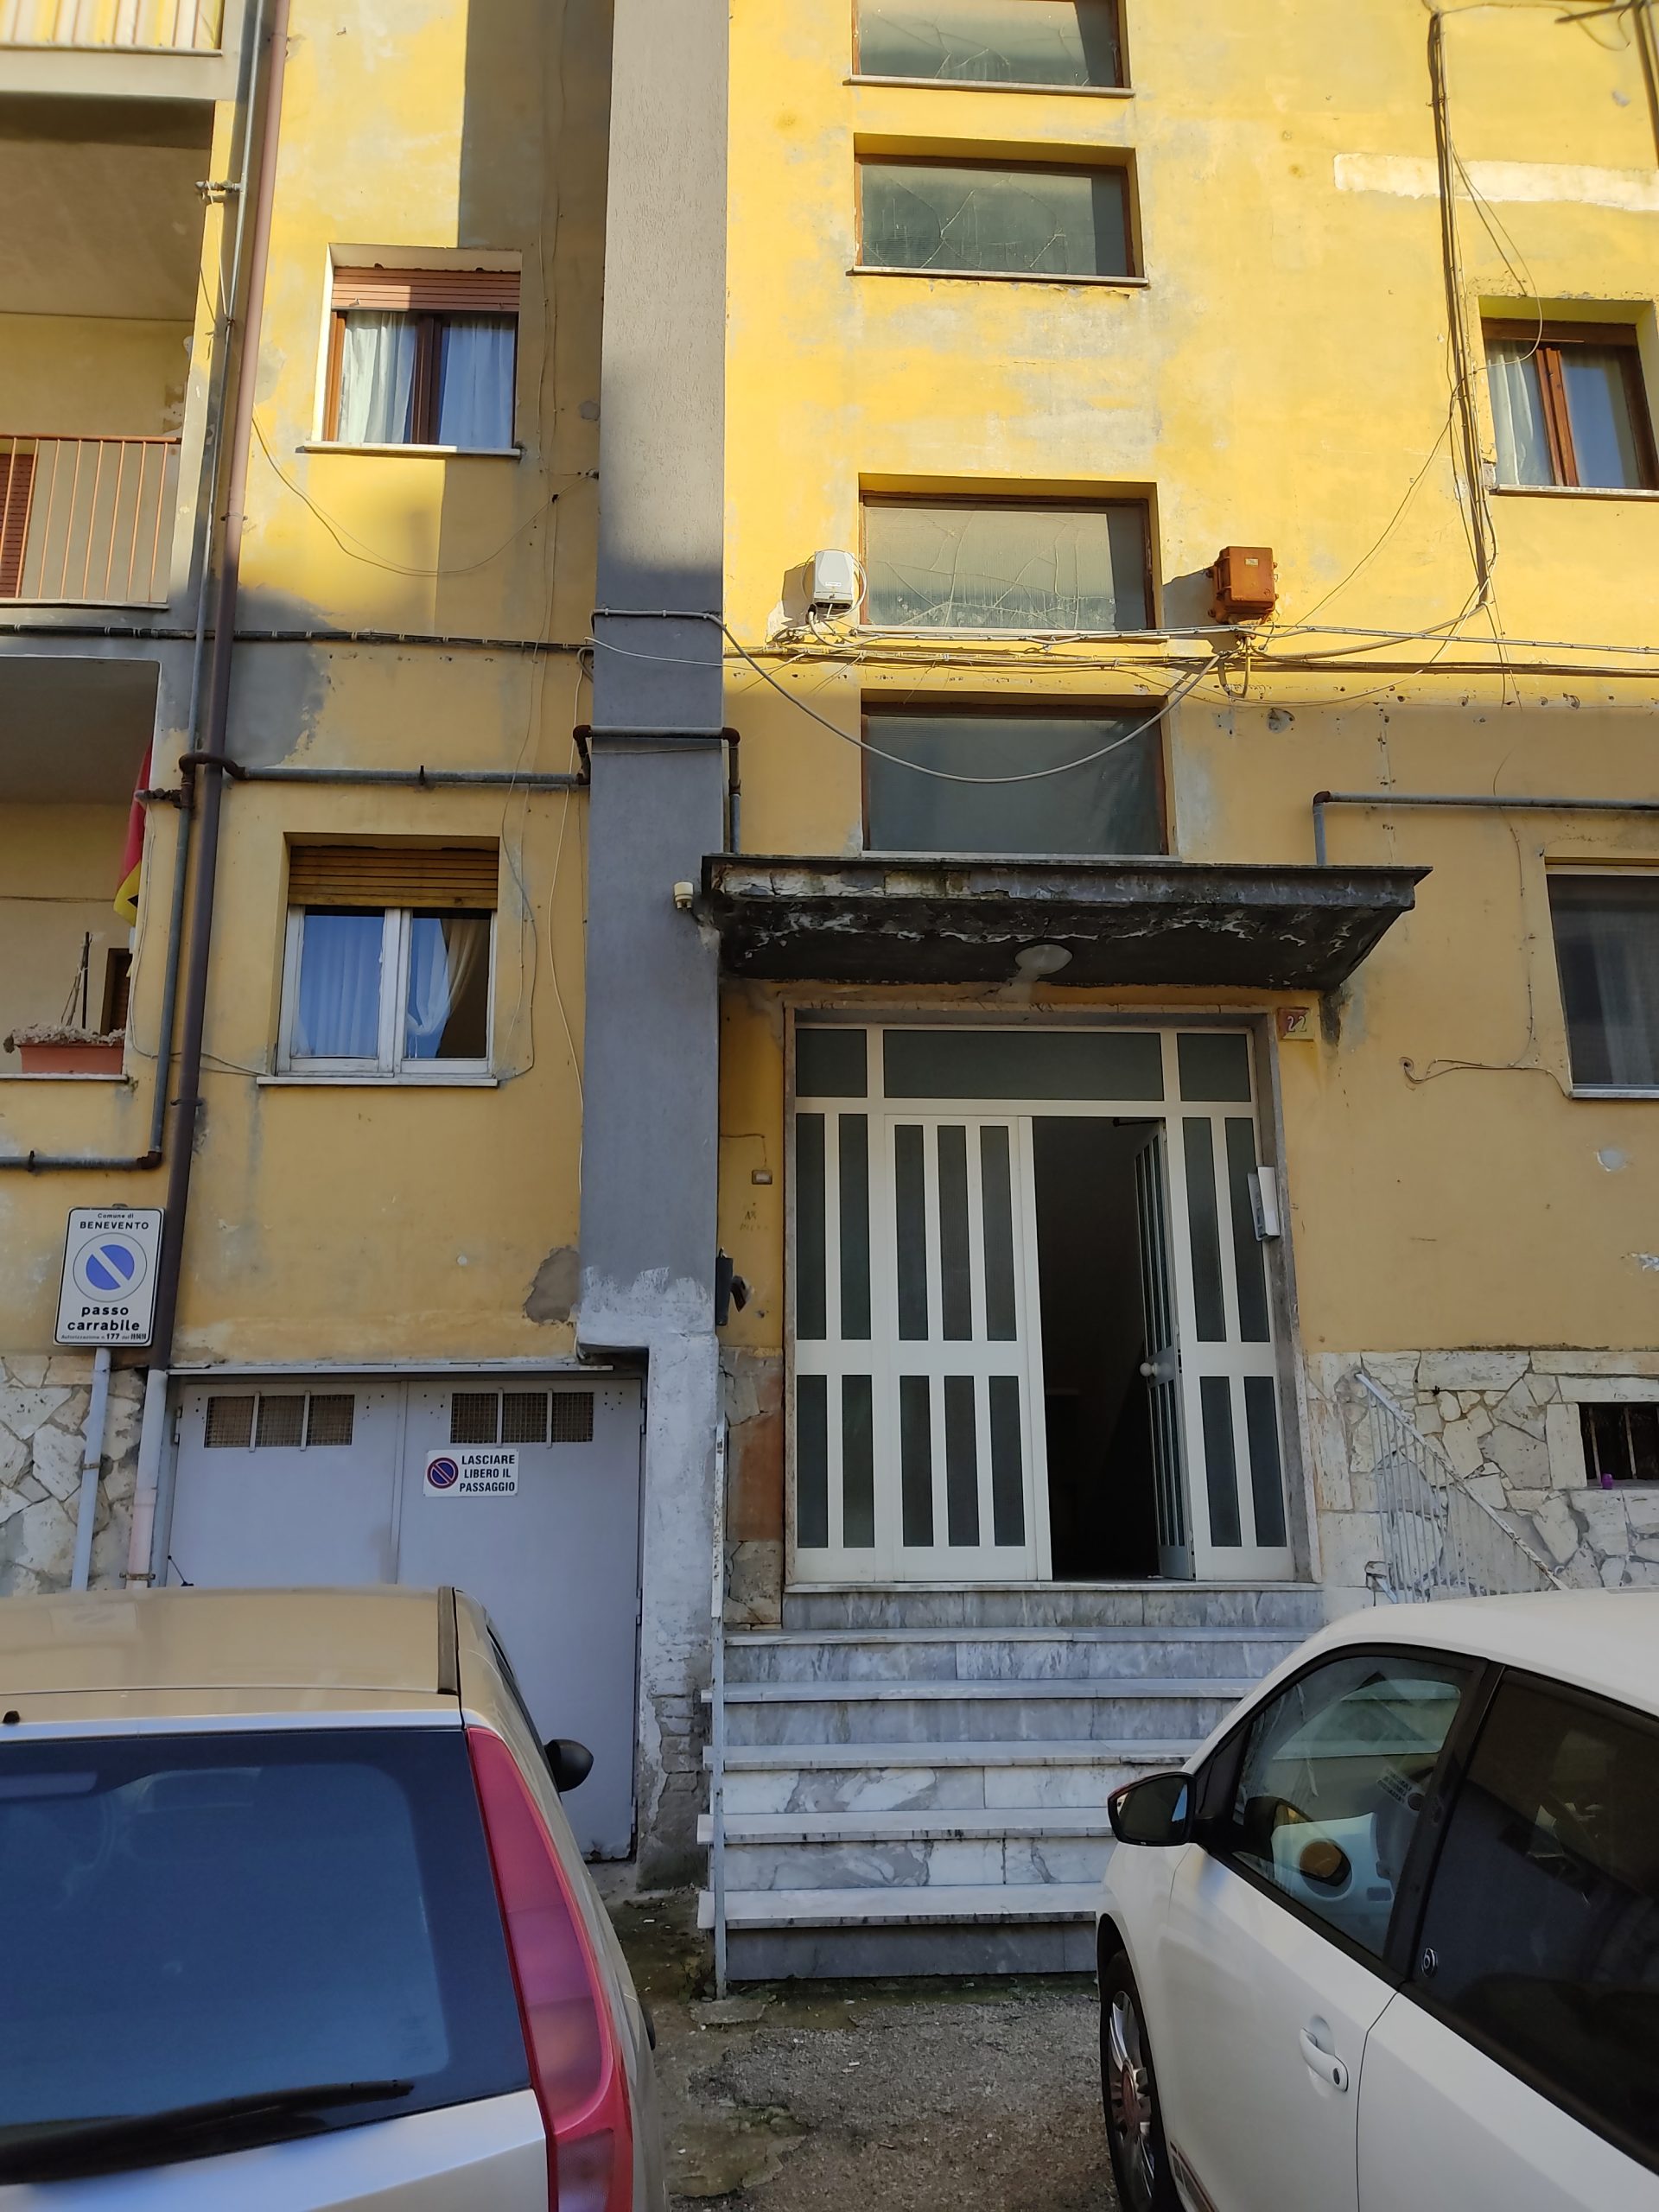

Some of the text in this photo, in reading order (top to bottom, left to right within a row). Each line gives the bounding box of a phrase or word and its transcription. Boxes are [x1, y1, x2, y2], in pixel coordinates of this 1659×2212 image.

[1287, 1015, 1306, 1033] 22
[79, 1221, 149, 1230] BENEVENTO
[81, 1306, 129, 1317] passo
[67, 1319, 140, 1331] carrabile
[461, 1455, 515, 1465] LASCIARE
[464, 1468, 512, 1478] LIBERO IL
[460, 1482, 515, 1492] PASSAGGIO
